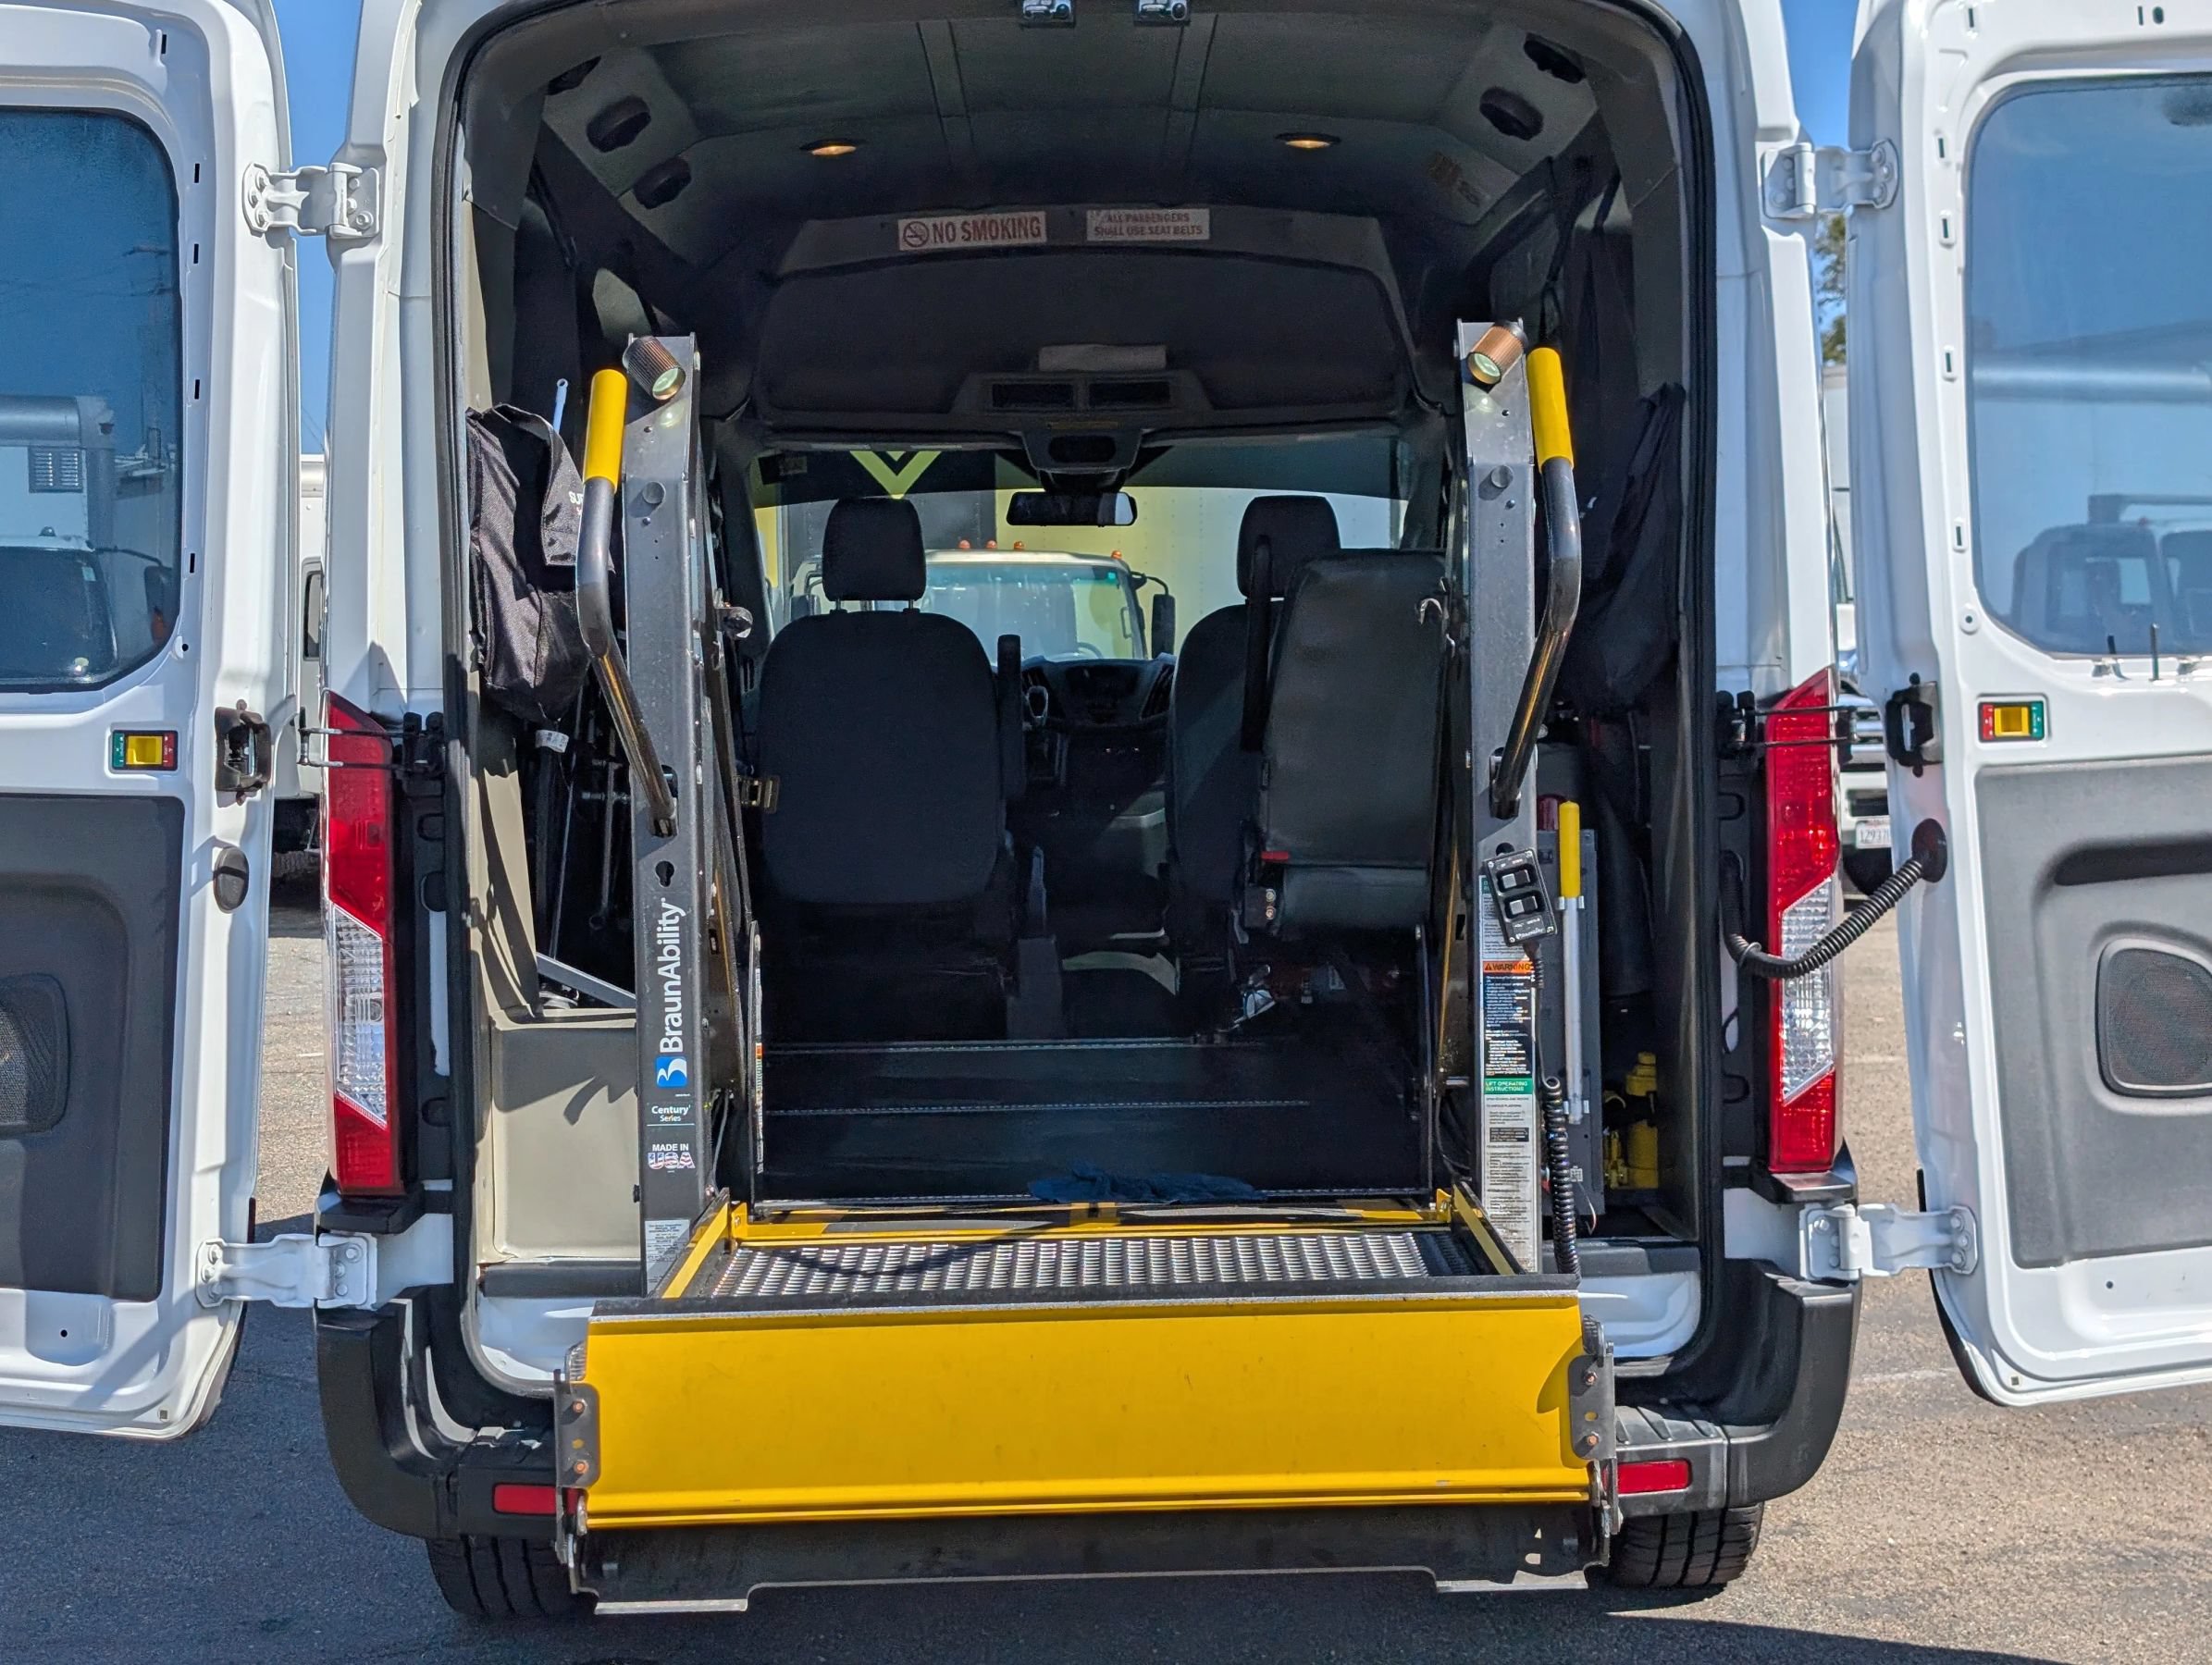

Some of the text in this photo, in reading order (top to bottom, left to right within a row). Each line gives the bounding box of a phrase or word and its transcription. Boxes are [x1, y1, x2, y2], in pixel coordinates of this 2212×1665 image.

[1125, 213, 1191, 223] PASSENGERS
[933, 216, 1042, 243] NO SMOKING
[1126, 226, 1146, 236] USE
[1146, 226, 1172, 236] SEAT
[1173, 225, 1204, 235] BELTS
[1492, 963, 1531, 971] WARNING
[657, 897, 686, 1054] BraunAbility
[651, 1104, 689, 1116] Century
[660, 1114, 682, 1122] Series
[652, 1143, 689, 1152] MADE IN
[648, 1152, 696, 1170] USA
